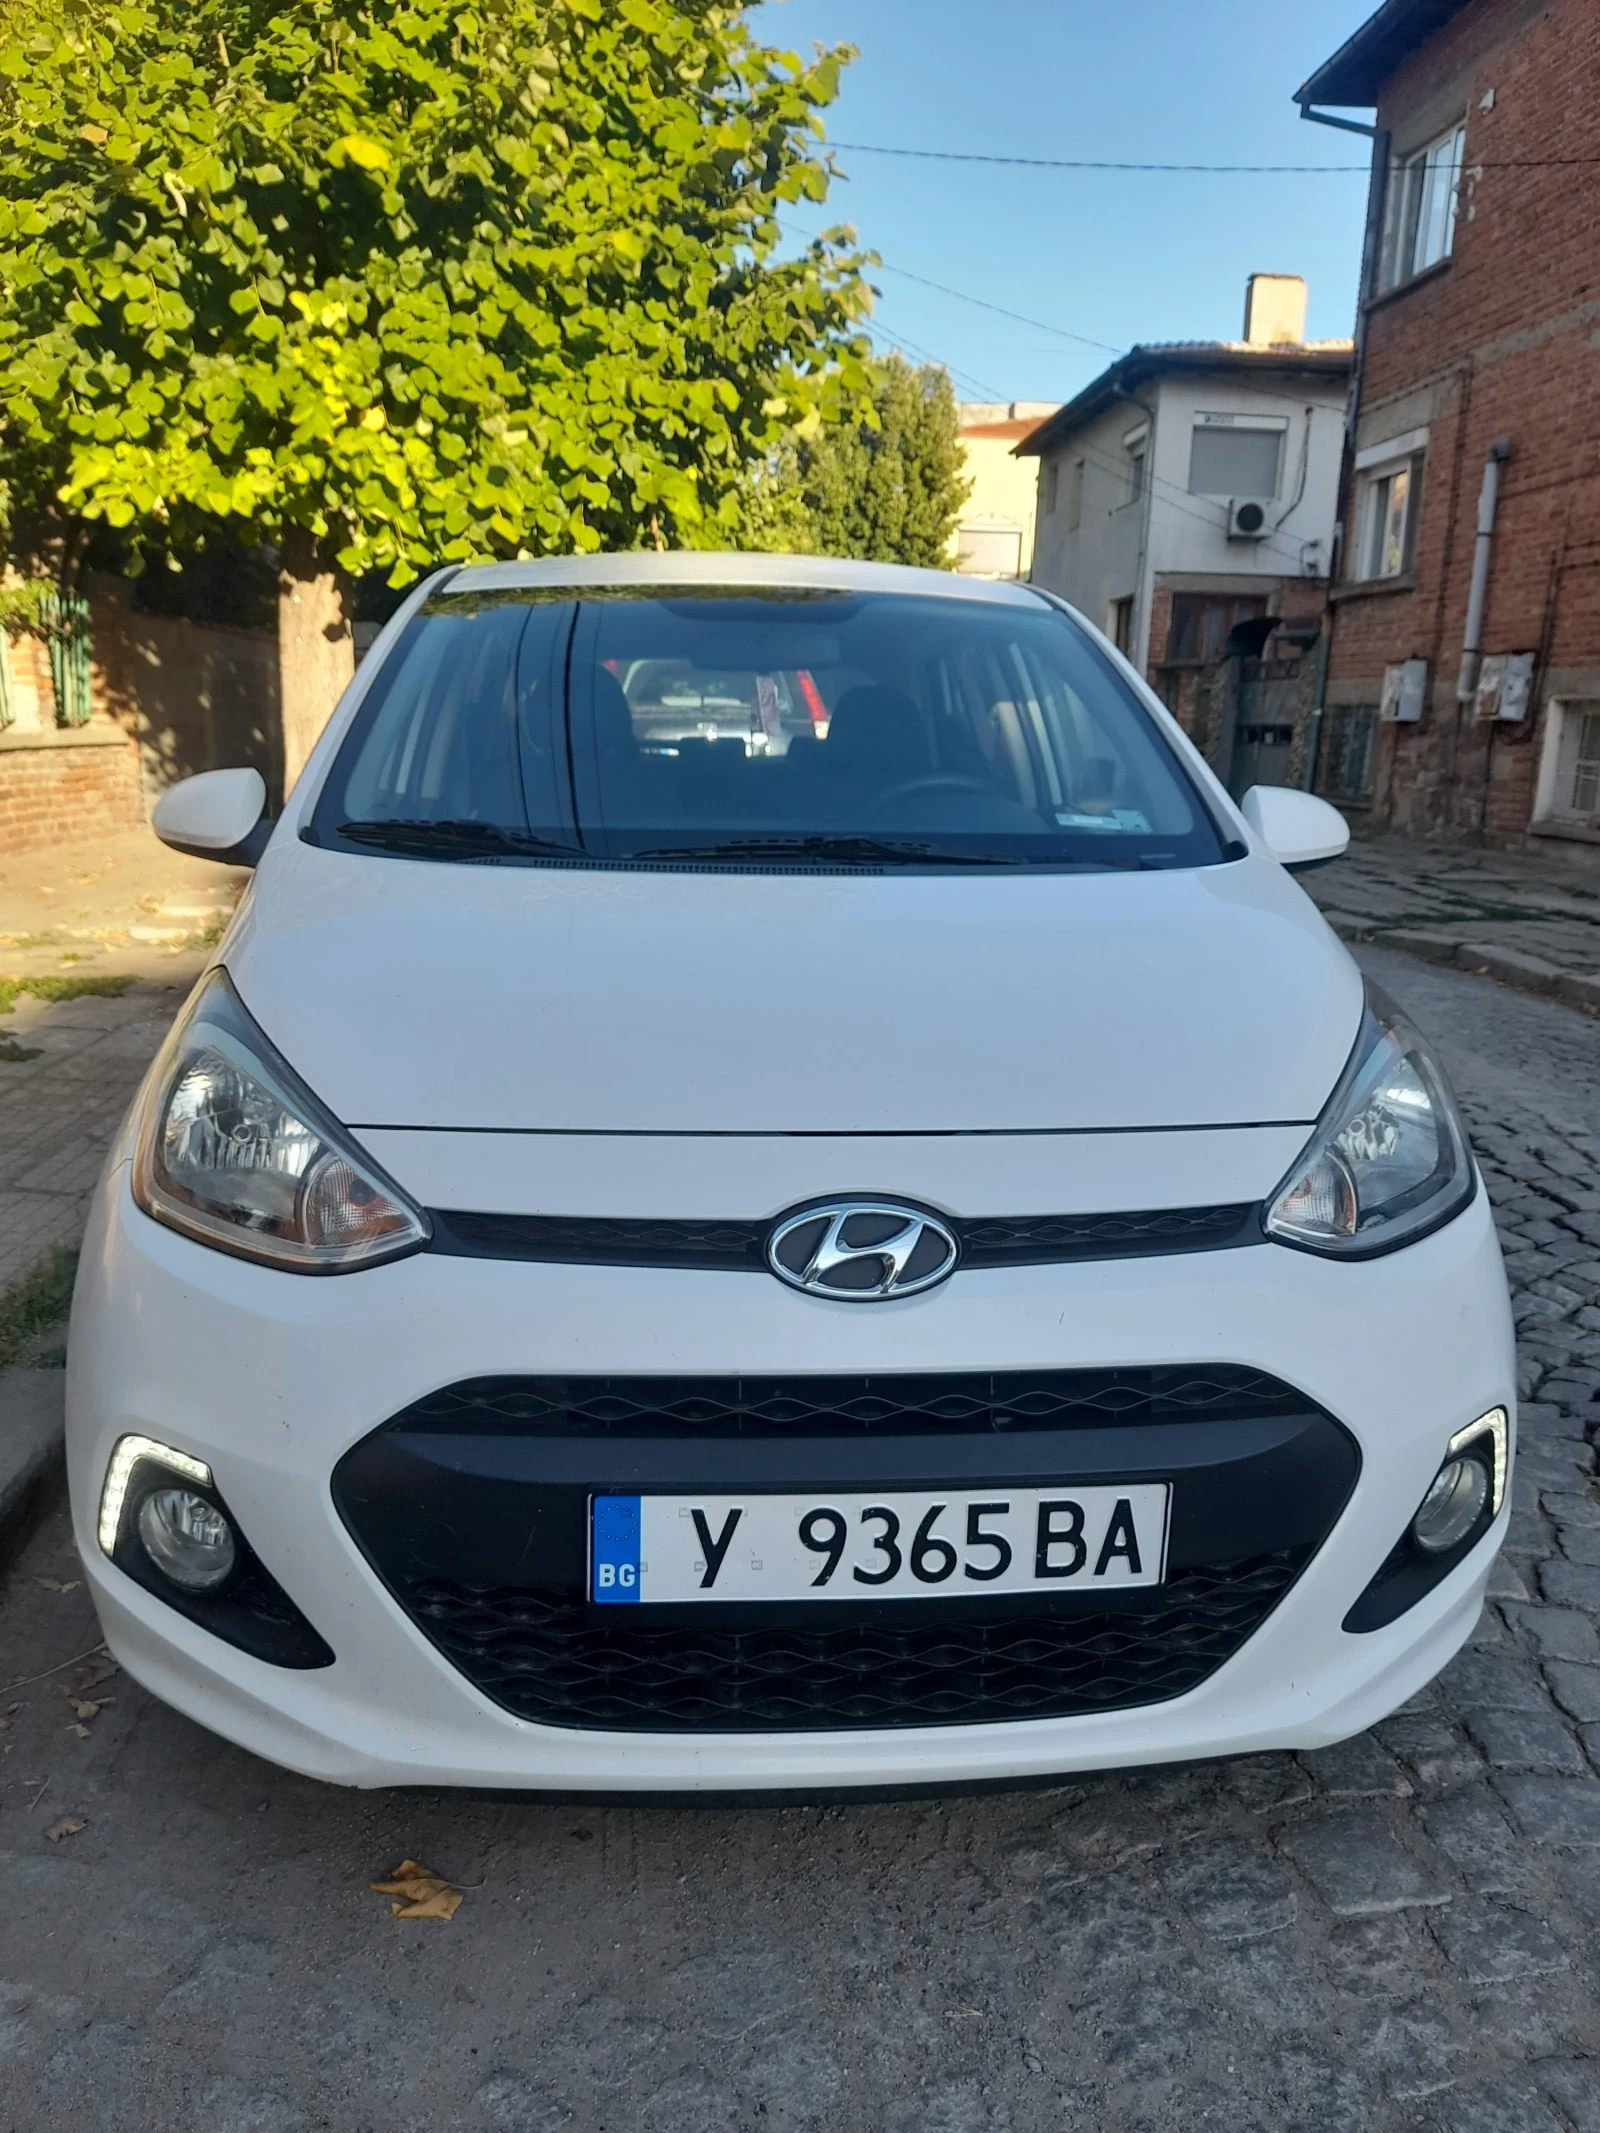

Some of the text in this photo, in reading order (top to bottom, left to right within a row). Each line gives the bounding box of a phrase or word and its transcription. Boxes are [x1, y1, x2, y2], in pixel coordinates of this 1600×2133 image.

[798, 1502, 1013, 1586] 9365
[1034, 1498, 1142, 1578] BA
[599, 1563, 636, 1588] BG
